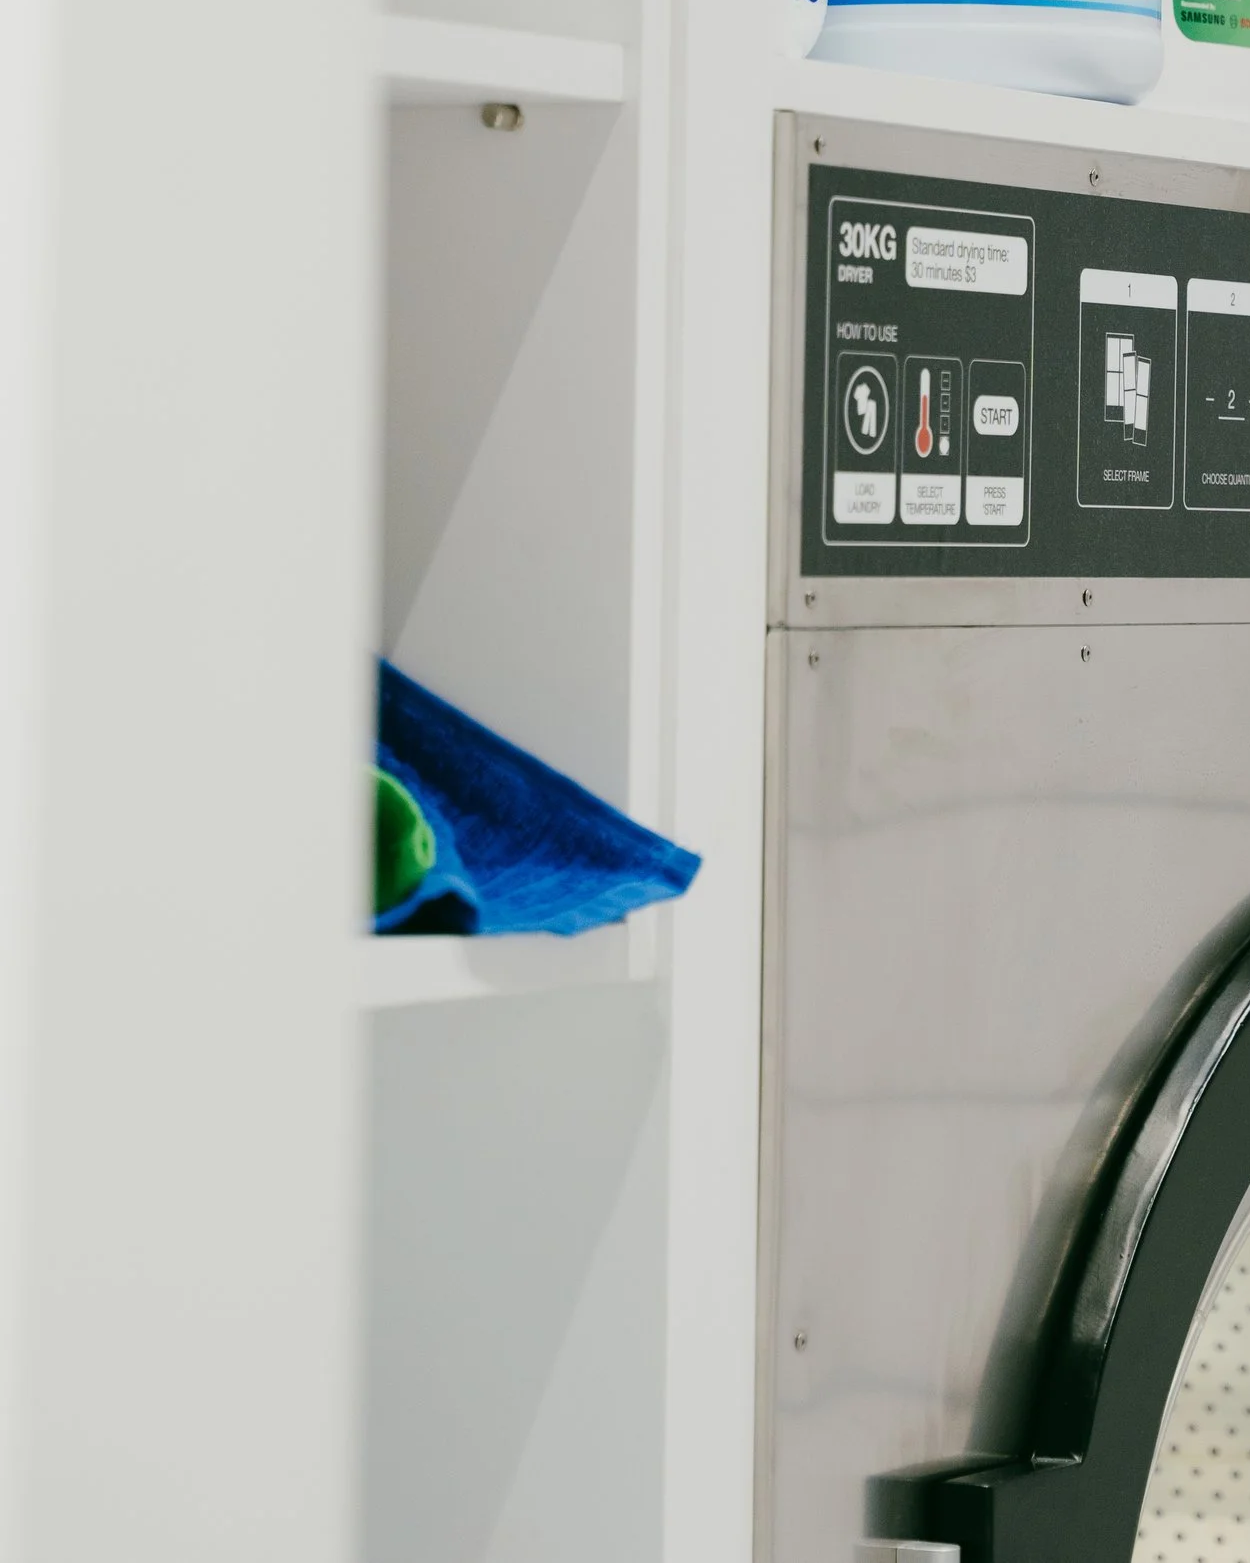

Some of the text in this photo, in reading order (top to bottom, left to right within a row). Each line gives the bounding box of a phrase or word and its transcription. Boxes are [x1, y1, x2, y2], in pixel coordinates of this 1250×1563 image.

[1180, 10, 1226, 26] SAMSUNG
[838, 221, 898, 261] 30KG
[911, 237, 1010, 265] Standard drying time:
[837, 264, 874, 284] DRYER
[911, 261, 977, 283] 30 minutes $3
[1230, 293, 1236, 307] 2
[836, 322, 899, 343] HOW TO USE
[1227, 389, 1236, 410] 2
[980, 407, 1013, 426] START
[1103, 468, 1150, 484] SELECT FRAME
[1202, 472, 1228, 486] CHOOSE
[854, 483, 875, 496] LOAD
[916, 486, 944, 499] SELECT
[983, 486, 1007, 499] PRESS
[847, 501, 881, 515] LAUNDRY
[905, 502, 956, 516] TEMPERATURE
